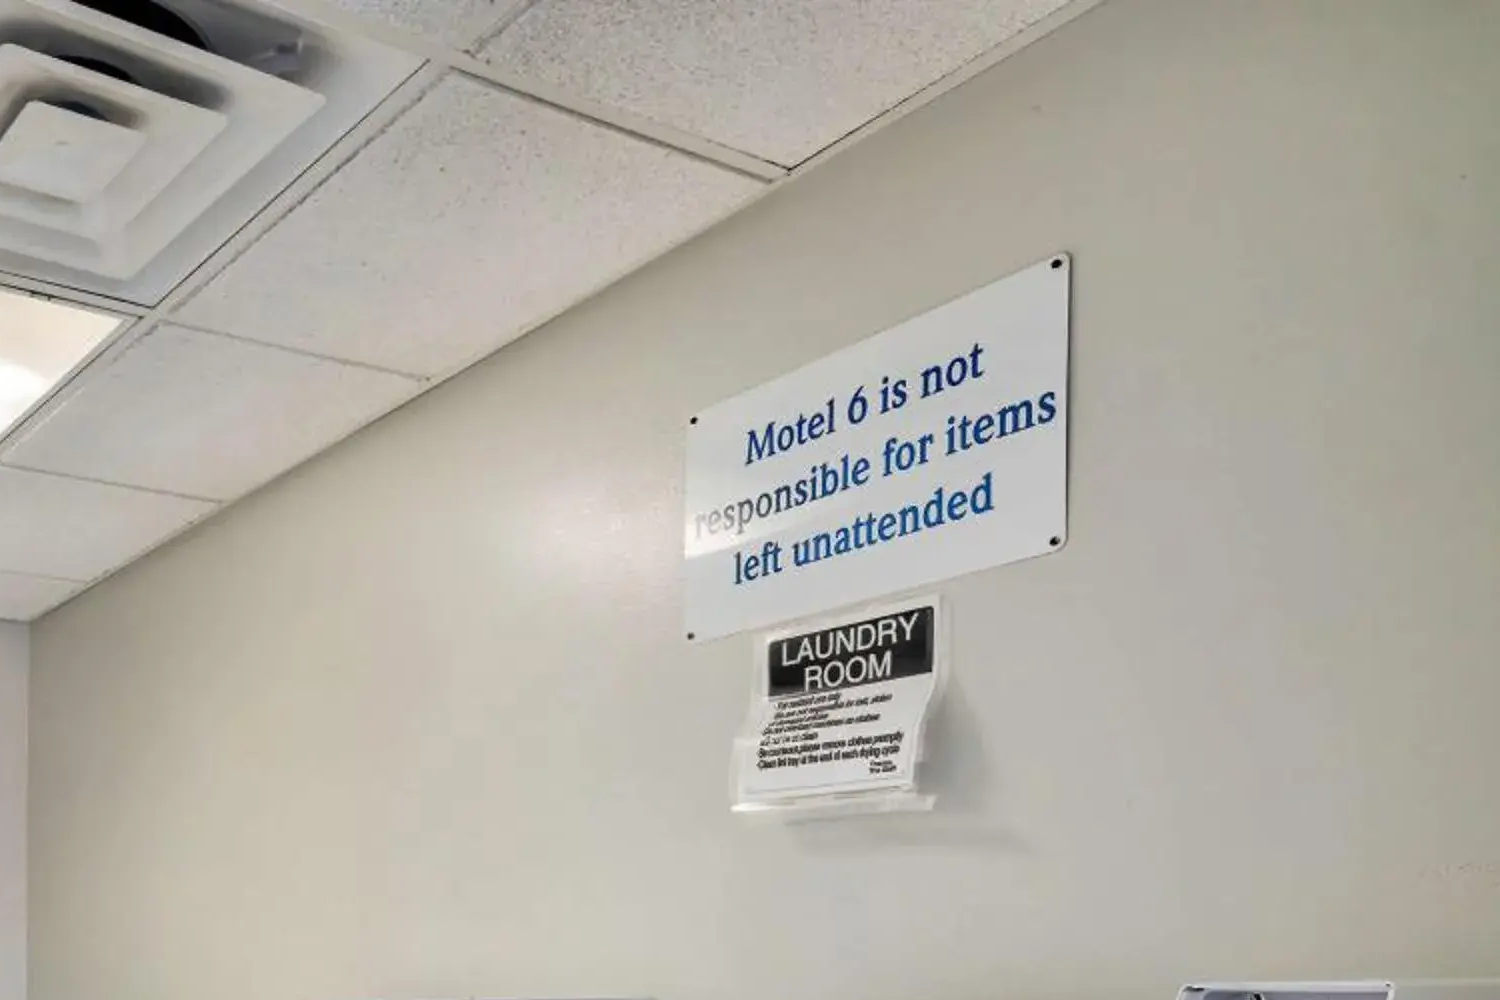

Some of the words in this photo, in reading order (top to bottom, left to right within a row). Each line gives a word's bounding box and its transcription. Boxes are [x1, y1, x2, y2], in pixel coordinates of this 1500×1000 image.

[744, 397, 836, 467] Motel
[847, 386, 869, 425] 6
[879, 376, 908, 414] is
[920, 343, 985, 399] not
[695, 454, 871, 539] responsible
[882, 432, 935, 477] for
[945, 391, 1058, 457] items
[733, 540, 783, 585] left
[793, 472, 995, 568] unattended
[781, 612, 919, 667] LAUNDRY
[804, 650, 892, 692] ROOM
